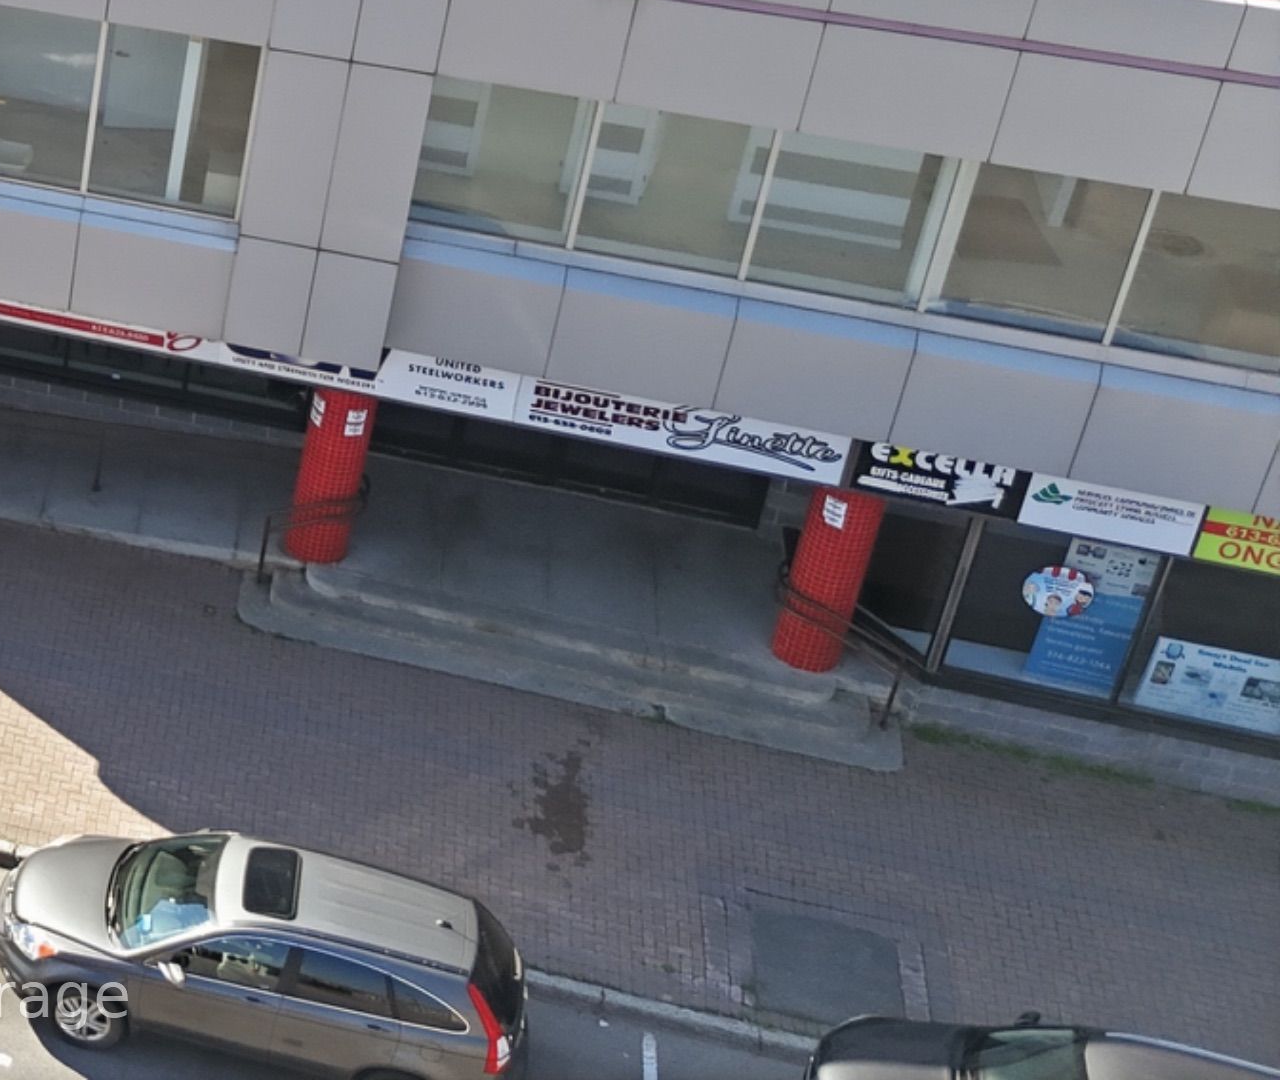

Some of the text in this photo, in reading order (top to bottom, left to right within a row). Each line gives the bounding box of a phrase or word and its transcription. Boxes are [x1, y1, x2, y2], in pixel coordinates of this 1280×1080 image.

[408, 363, 505, 390] STEELWORKERS
[435, 357, 482, 374] UNITED
[531, 398, 661, 432] JEWELERS
[534, 384, 689, 424] BIJOUTERIE
[871, 441, 1016, 487] EXCELLA
